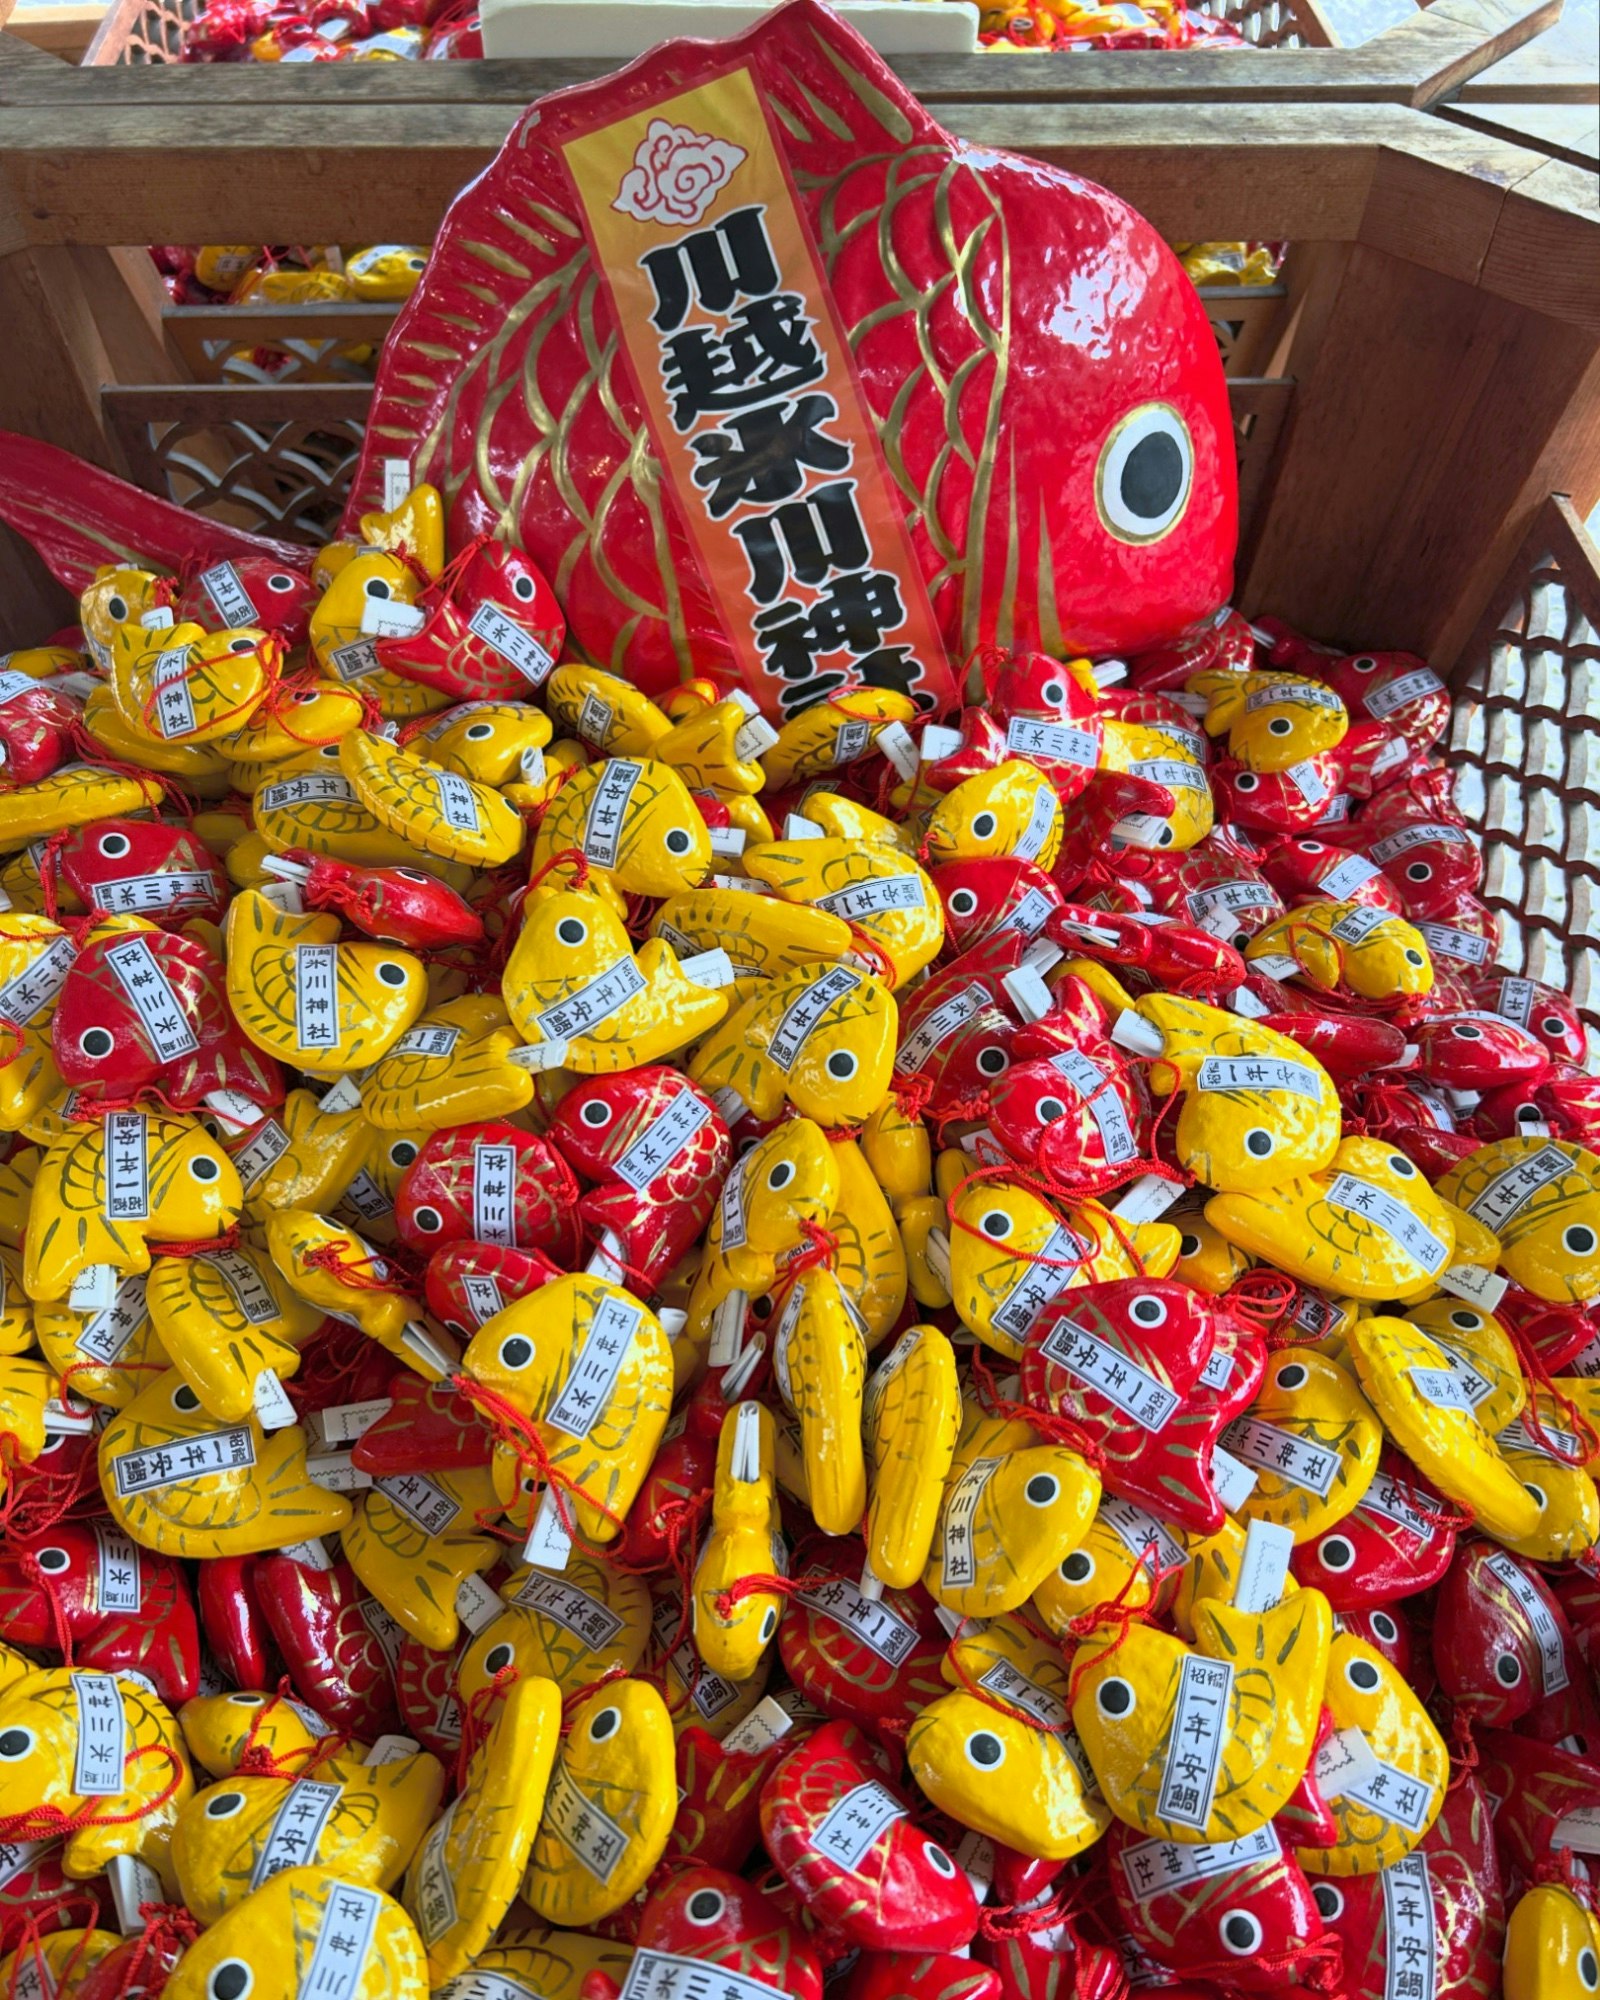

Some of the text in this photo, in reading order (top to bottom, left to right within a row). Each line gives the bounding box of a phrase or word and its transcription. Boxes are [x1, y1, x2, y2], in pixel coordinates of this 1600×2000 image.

[483, 1153, 511, 1246] 氷川神社
[93, 1275, 148, 1353] 川神社
